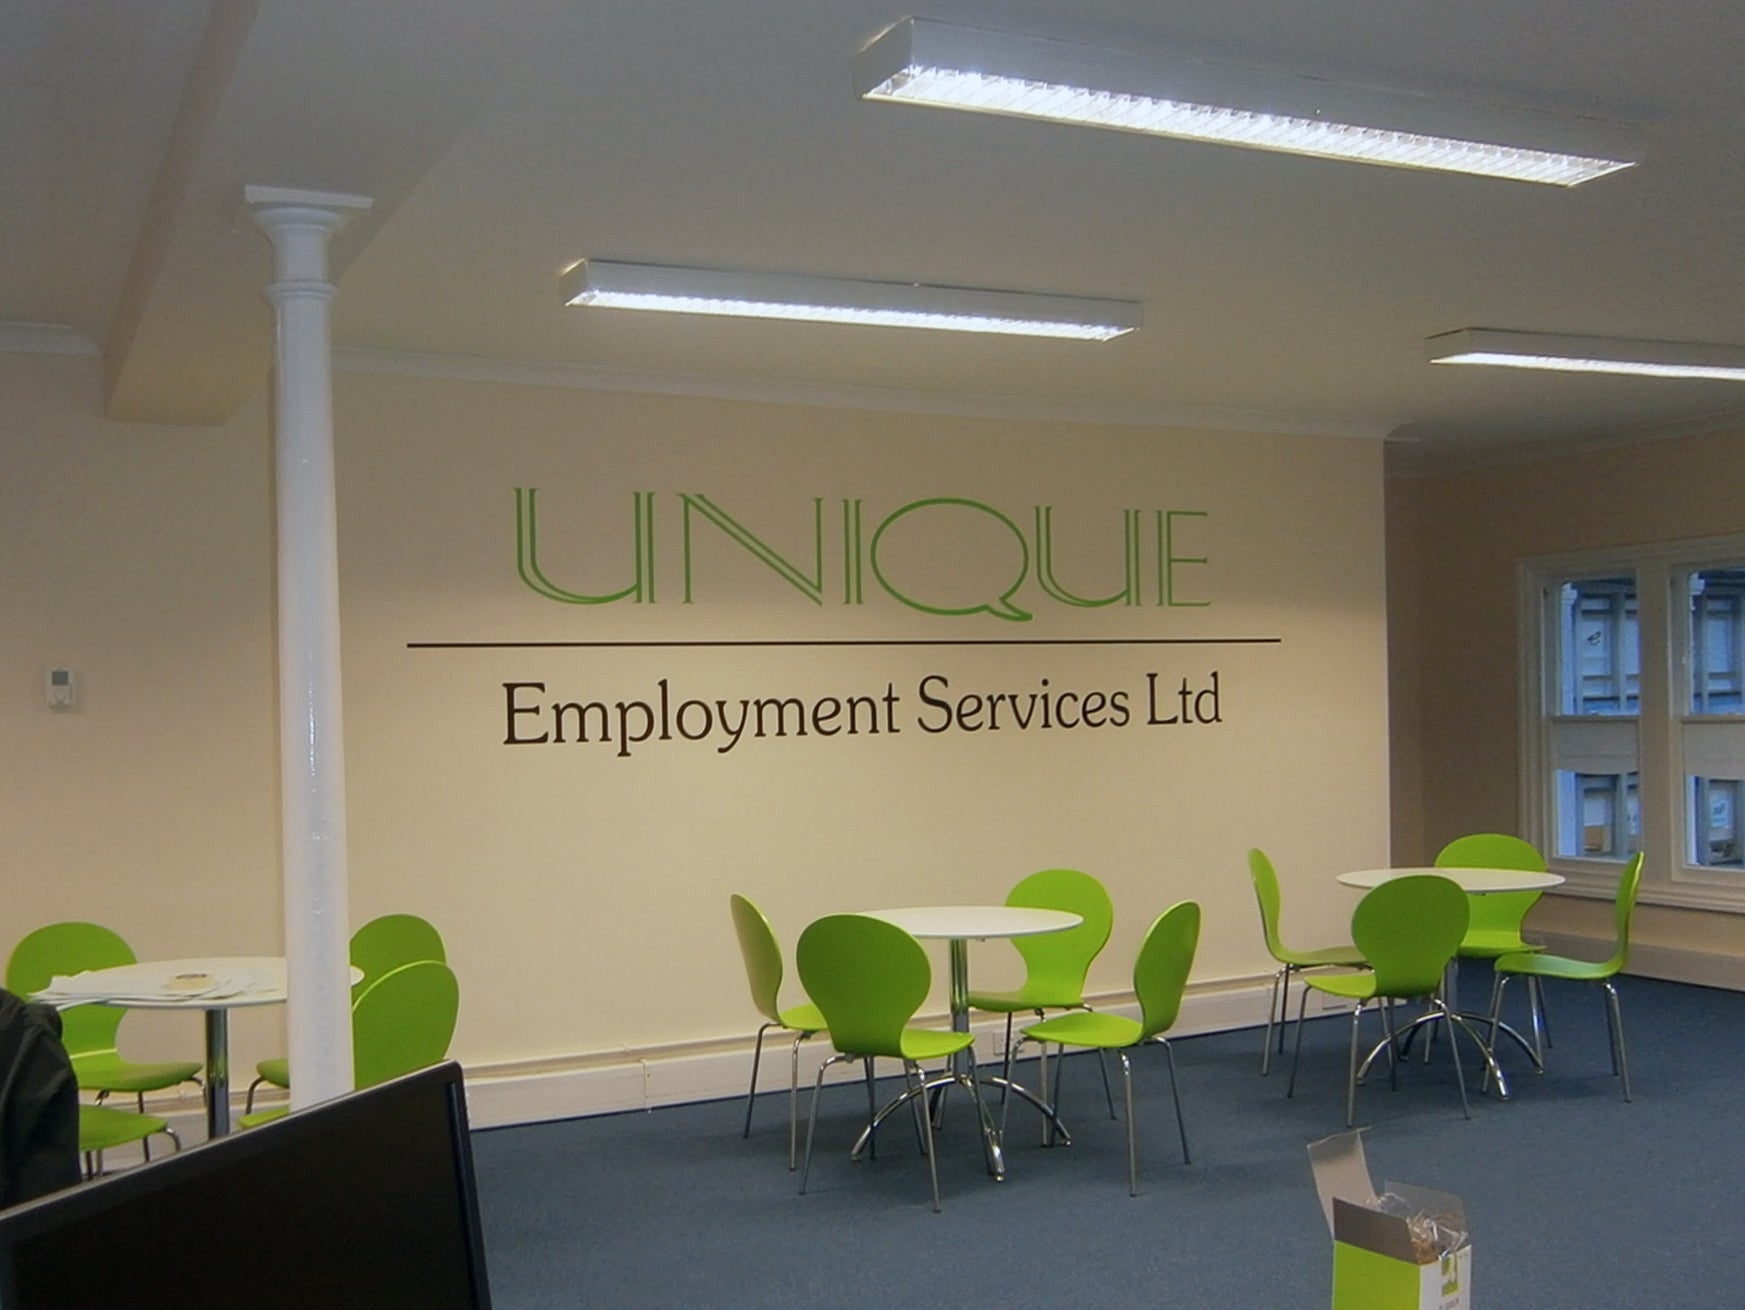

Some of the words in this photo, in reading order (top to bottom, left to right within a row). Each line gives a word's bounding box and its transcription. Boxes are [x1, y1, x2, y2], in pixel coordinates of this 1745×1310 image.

[513, 487, 1211, 622] UNIQUE
[502, 678, 901, 757] Employment
[917, 675, 1130, 734] Services
[1146, 671, 1223, 725] Ltd
